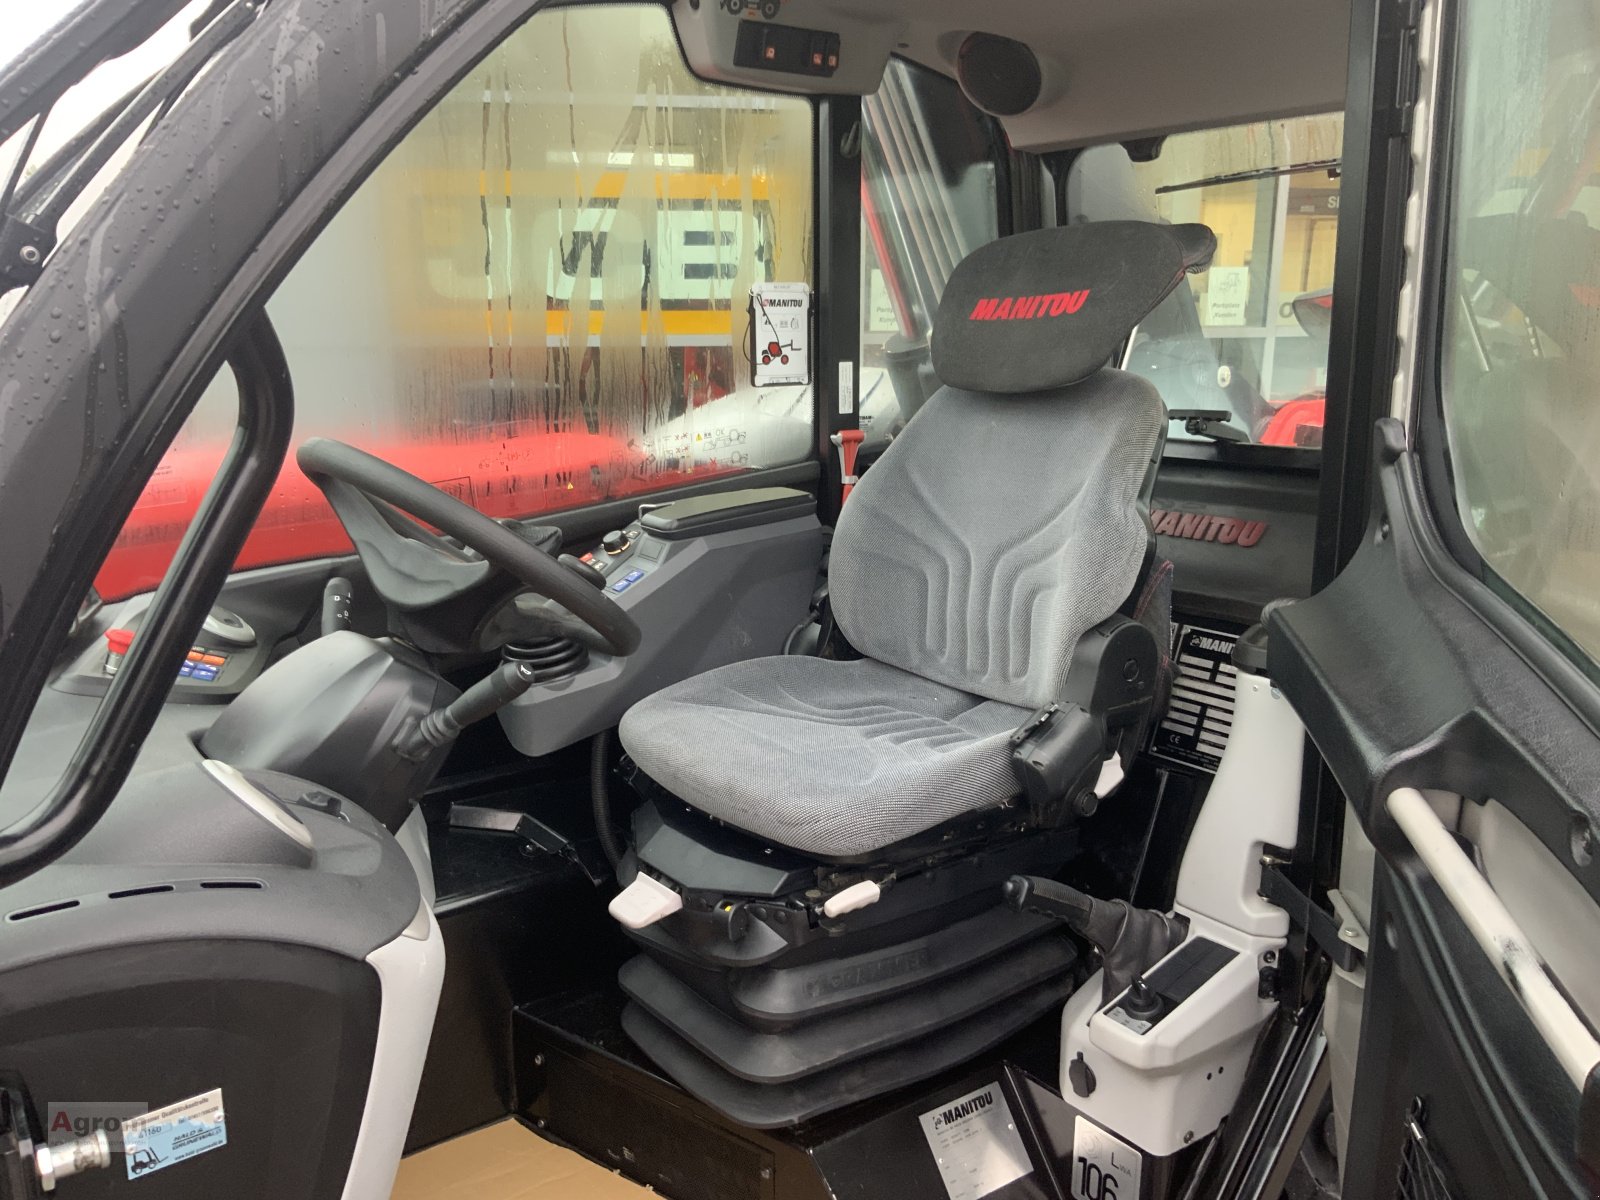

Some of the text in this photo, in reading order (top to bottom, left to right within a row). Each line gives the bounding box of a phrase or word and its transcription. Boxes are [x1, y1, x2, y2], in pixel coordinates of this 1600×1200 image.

[768, 299, 803, 308] MANITOU
[969, 289, 1091, 320] MANITOU
[943, 1091, 993, 1125] MANITOU
[1078, 1156, 1119, 1200] 106
